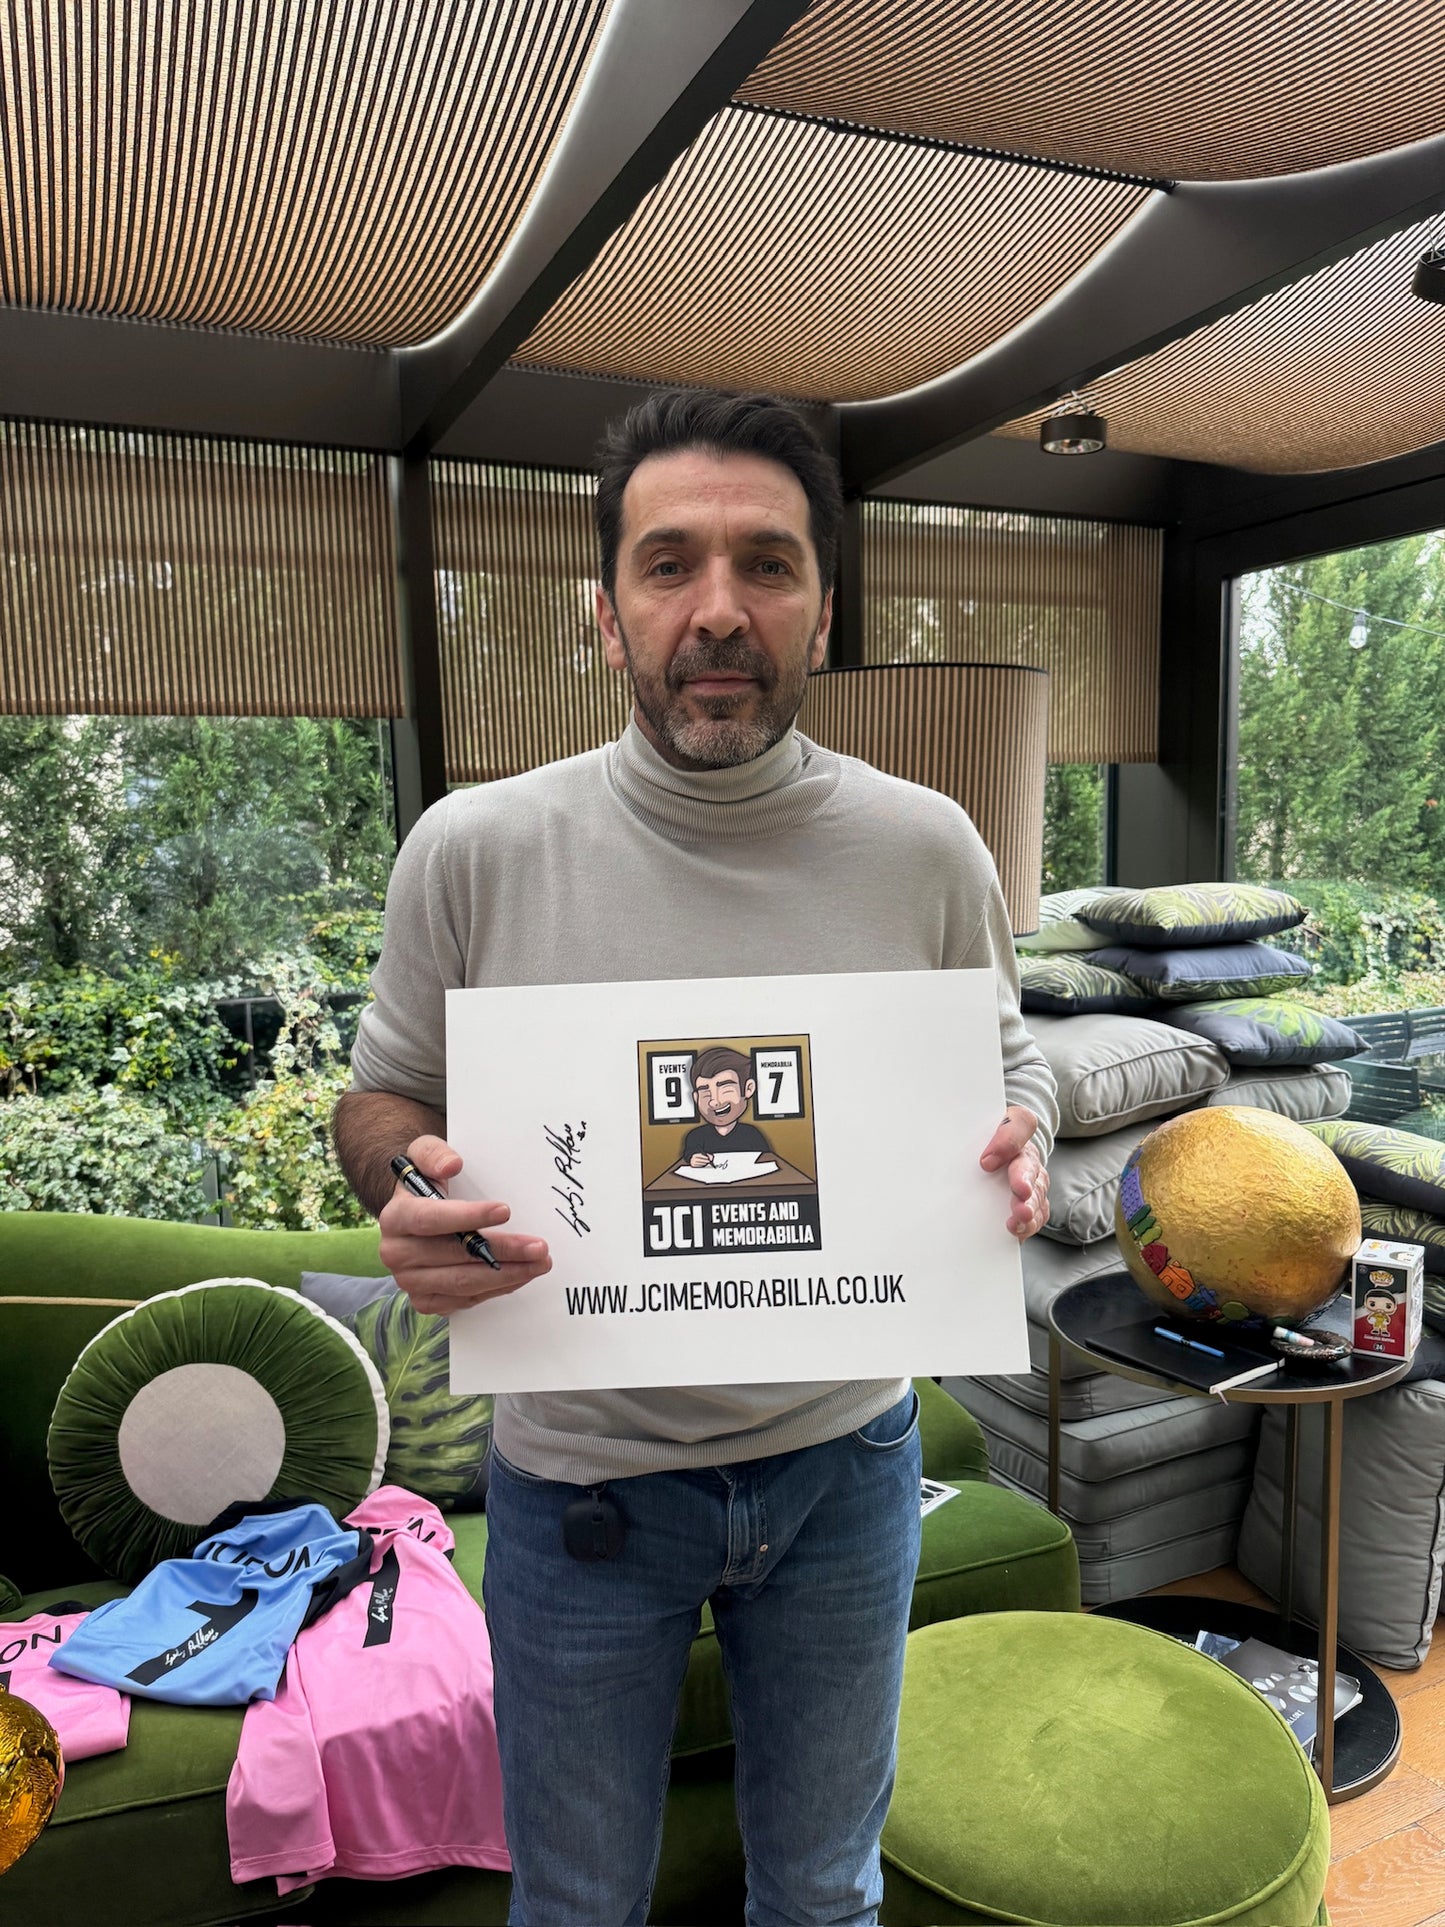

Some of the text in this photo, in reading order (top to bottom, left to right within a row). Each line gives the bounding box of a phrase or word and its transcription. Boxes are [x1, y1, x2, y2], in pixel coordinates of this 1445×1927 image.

[659, 1064, 687, 1074] EVENTS
[760, 1061, 793, 1069] MEMORABILIA
[665, 1076, 682, 1108] 9
[768, 1072, 784, 1104] 7
[711, 1201, 799, 1223] EVENTS AND
[649, 1204, 704, 1250] JCI
[712, 1224, 815, 1247] MEMORABILIA
[565, 1274, 907, 1315] WWW.JCIMEMORABILIA.CO.UK
